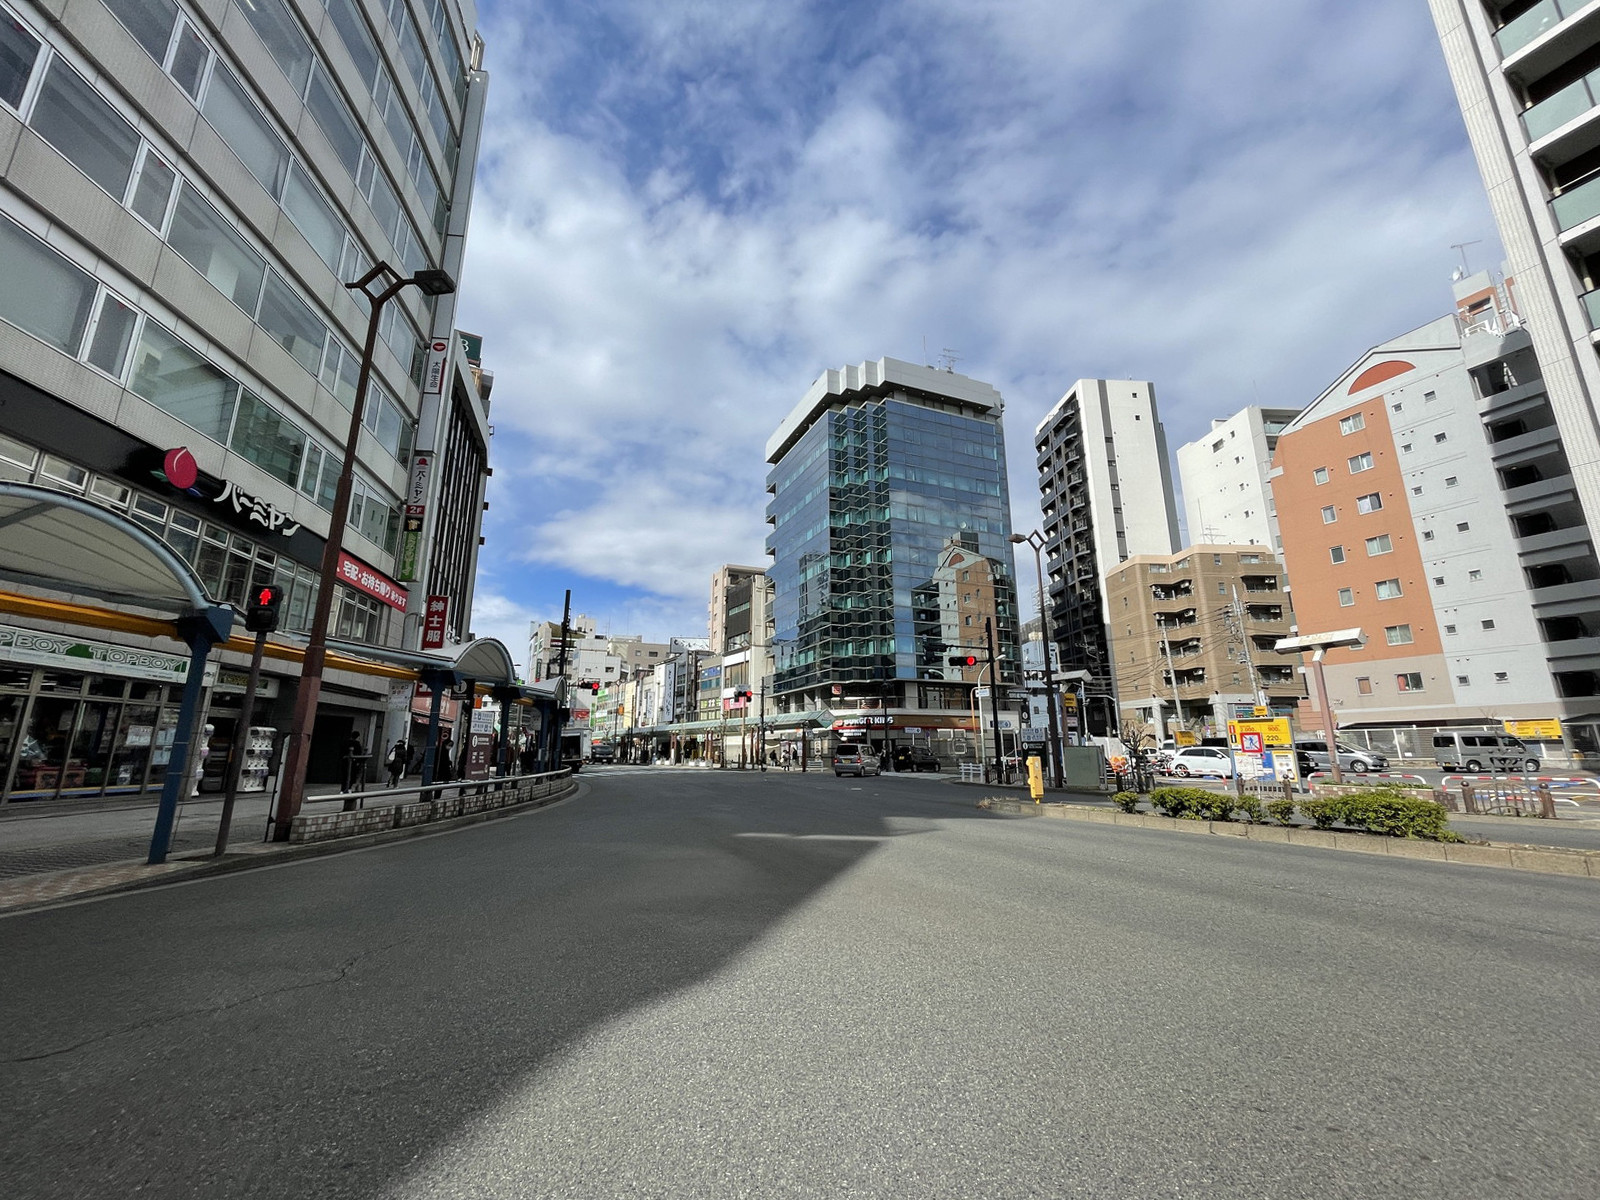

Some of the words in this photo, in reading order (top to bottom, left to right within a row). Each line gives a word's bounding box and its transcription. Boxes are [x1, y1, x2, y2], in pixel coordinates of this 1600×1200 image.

[213, 480, 300, 536] バーミヤン
[410, 505, 423, 514] 2F
[426, 600, 445, 643] 紳士服
[88, 646, 183, 671] TOPBOY
